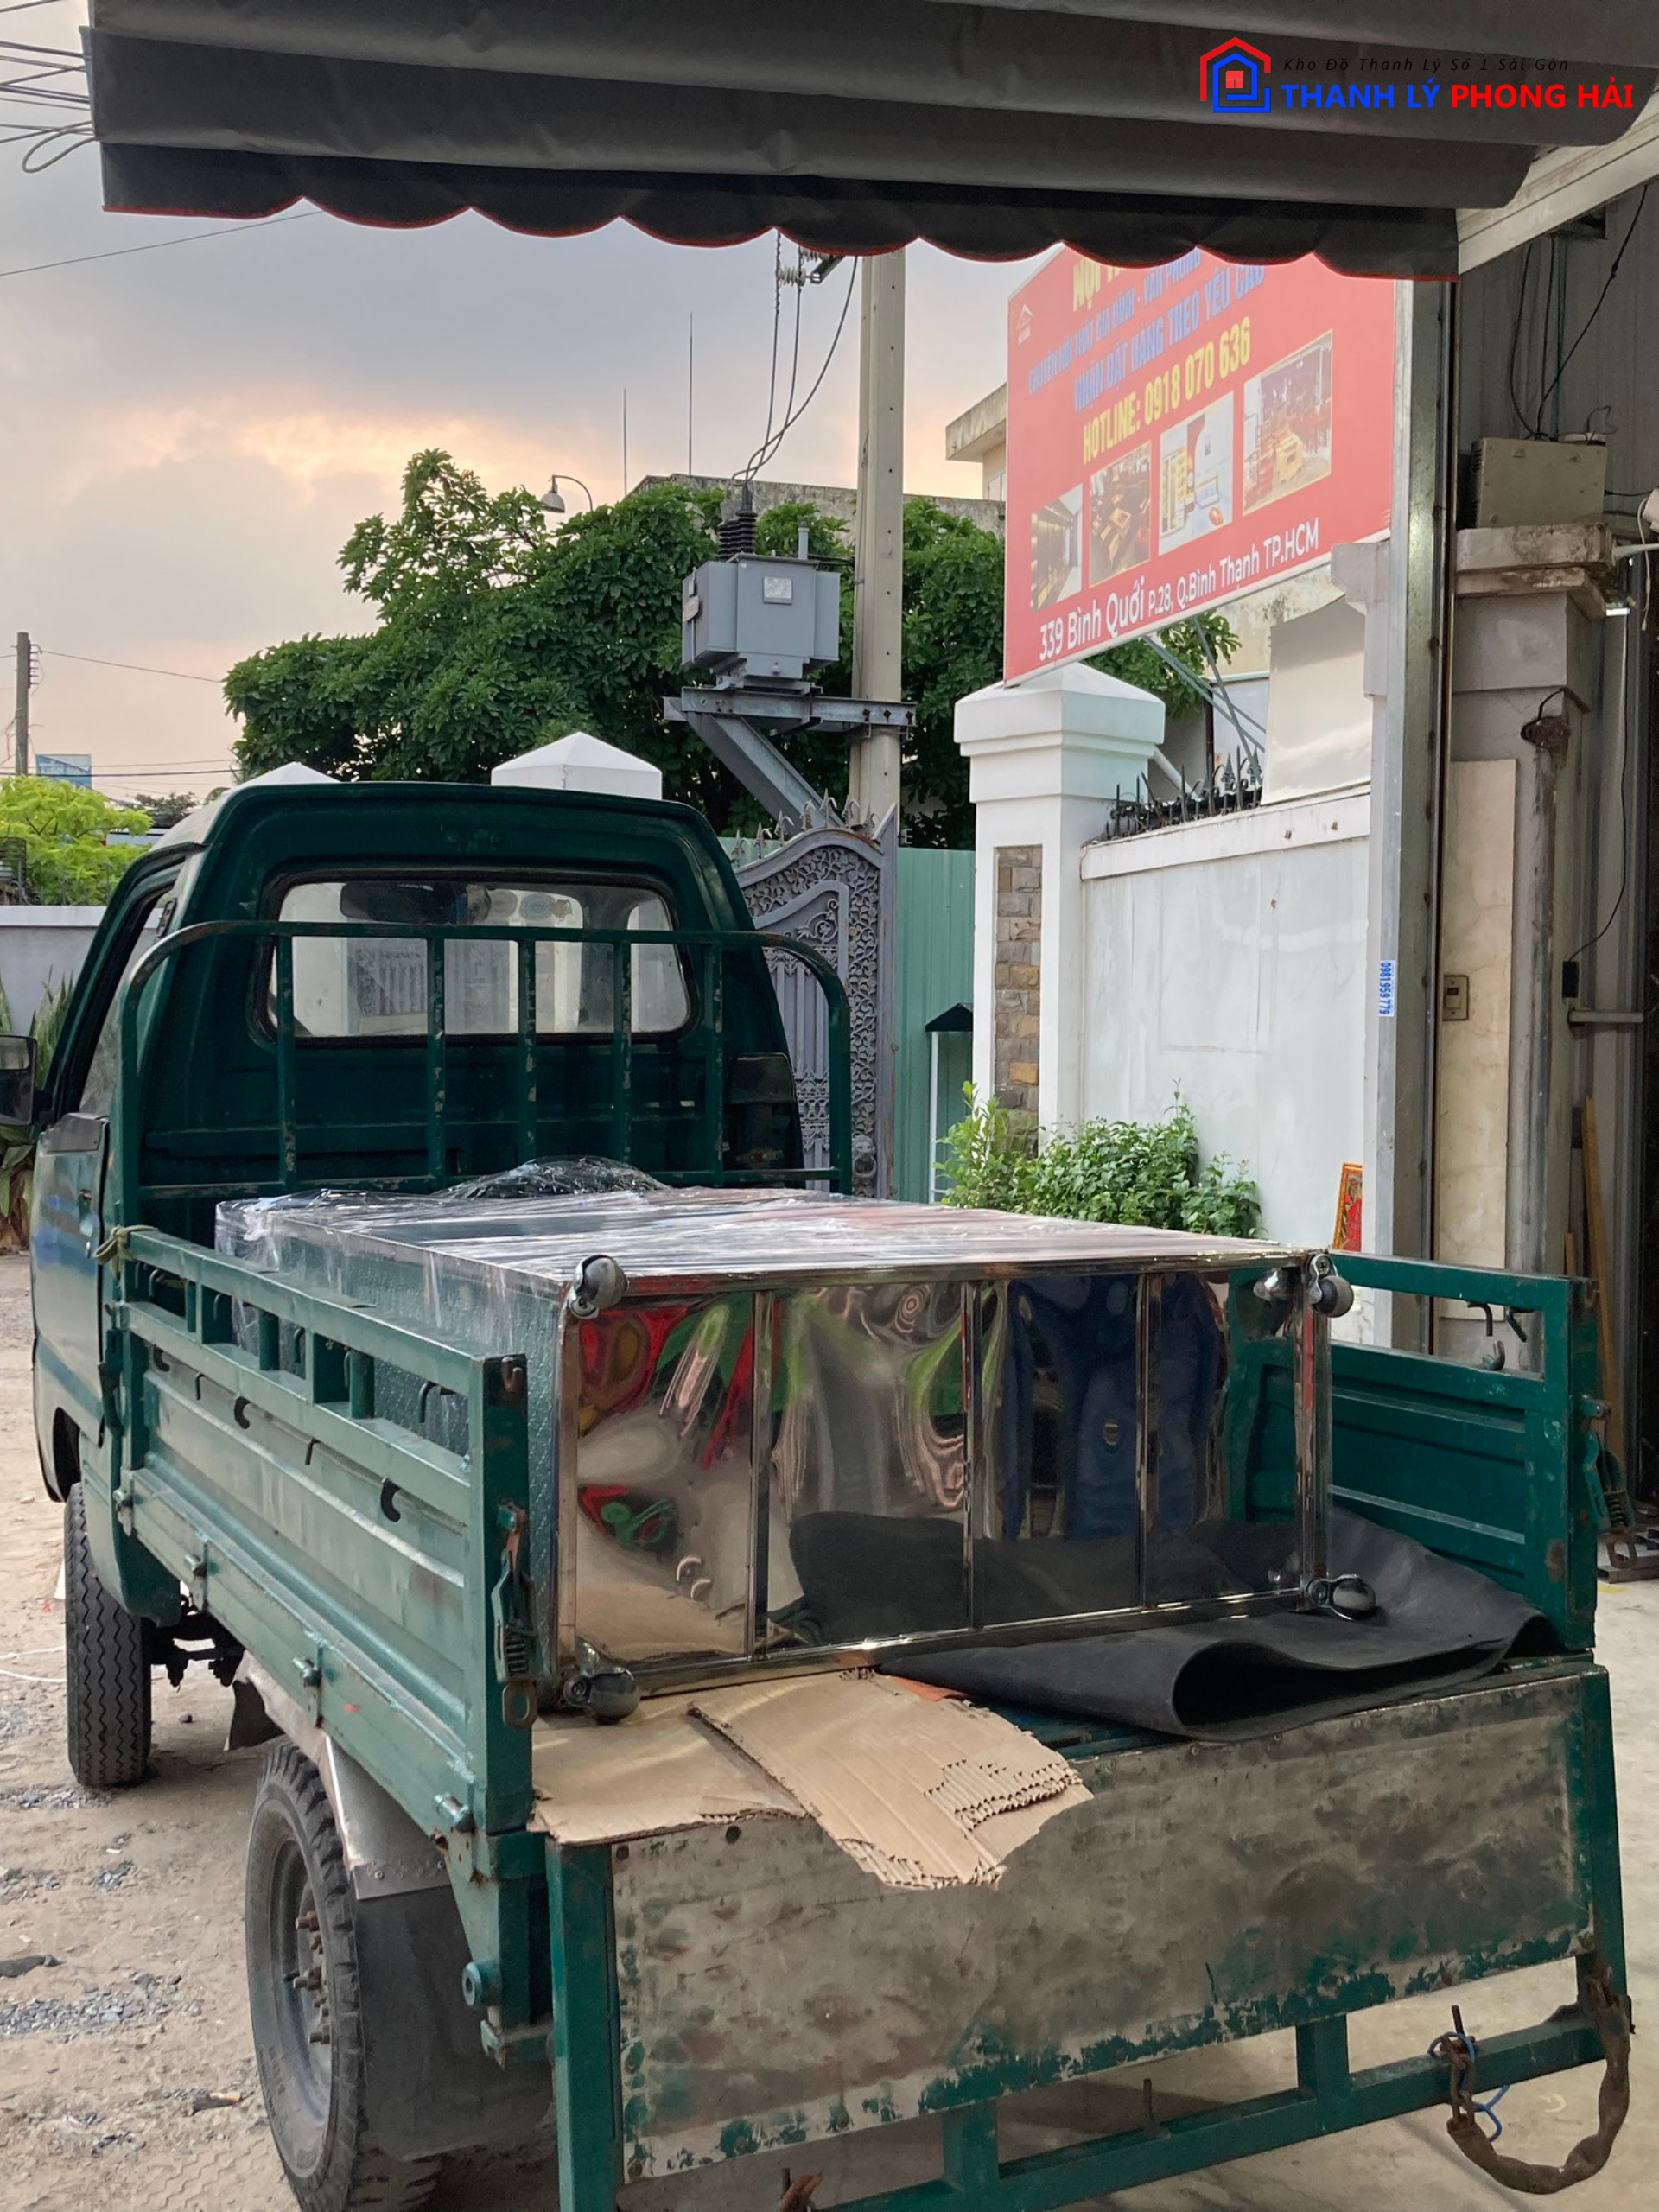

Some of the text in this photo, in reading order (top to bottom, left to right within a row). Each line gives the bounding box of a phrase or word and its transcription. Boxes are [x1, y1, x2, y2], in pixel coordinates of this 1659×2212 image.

[1167, 289, 1200, 346] THEO
[1204, 266, 1230, 321] YÊU
[1083, 315, 1251, 466] HOTLINE: 0918 070 636
[1039, 517, 1319, 662] 339 Bình Quới P.28, Q.Bình Thạnh TP.HCM
